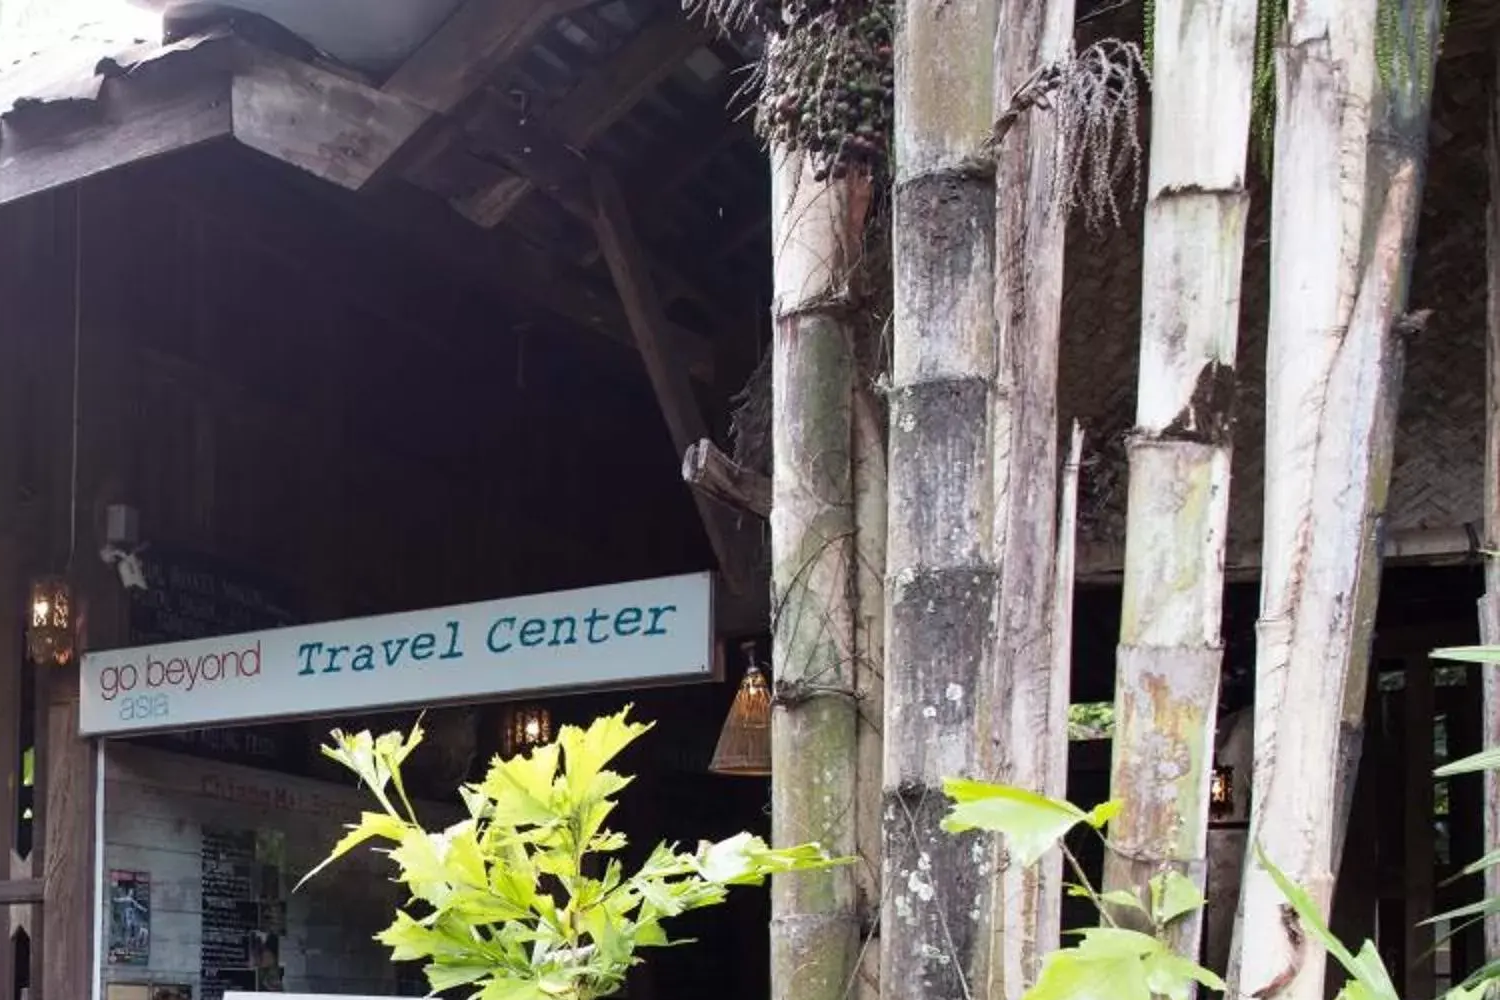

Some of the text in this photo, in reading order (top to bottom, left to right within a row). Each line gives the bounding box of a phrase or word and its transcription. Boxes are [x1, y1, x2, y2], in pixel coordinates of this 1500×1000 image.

[298, 602, 677, 677] Travel Center
[99, 641, 262, 702] go beyond
[118, 691, 170, 721] asia
